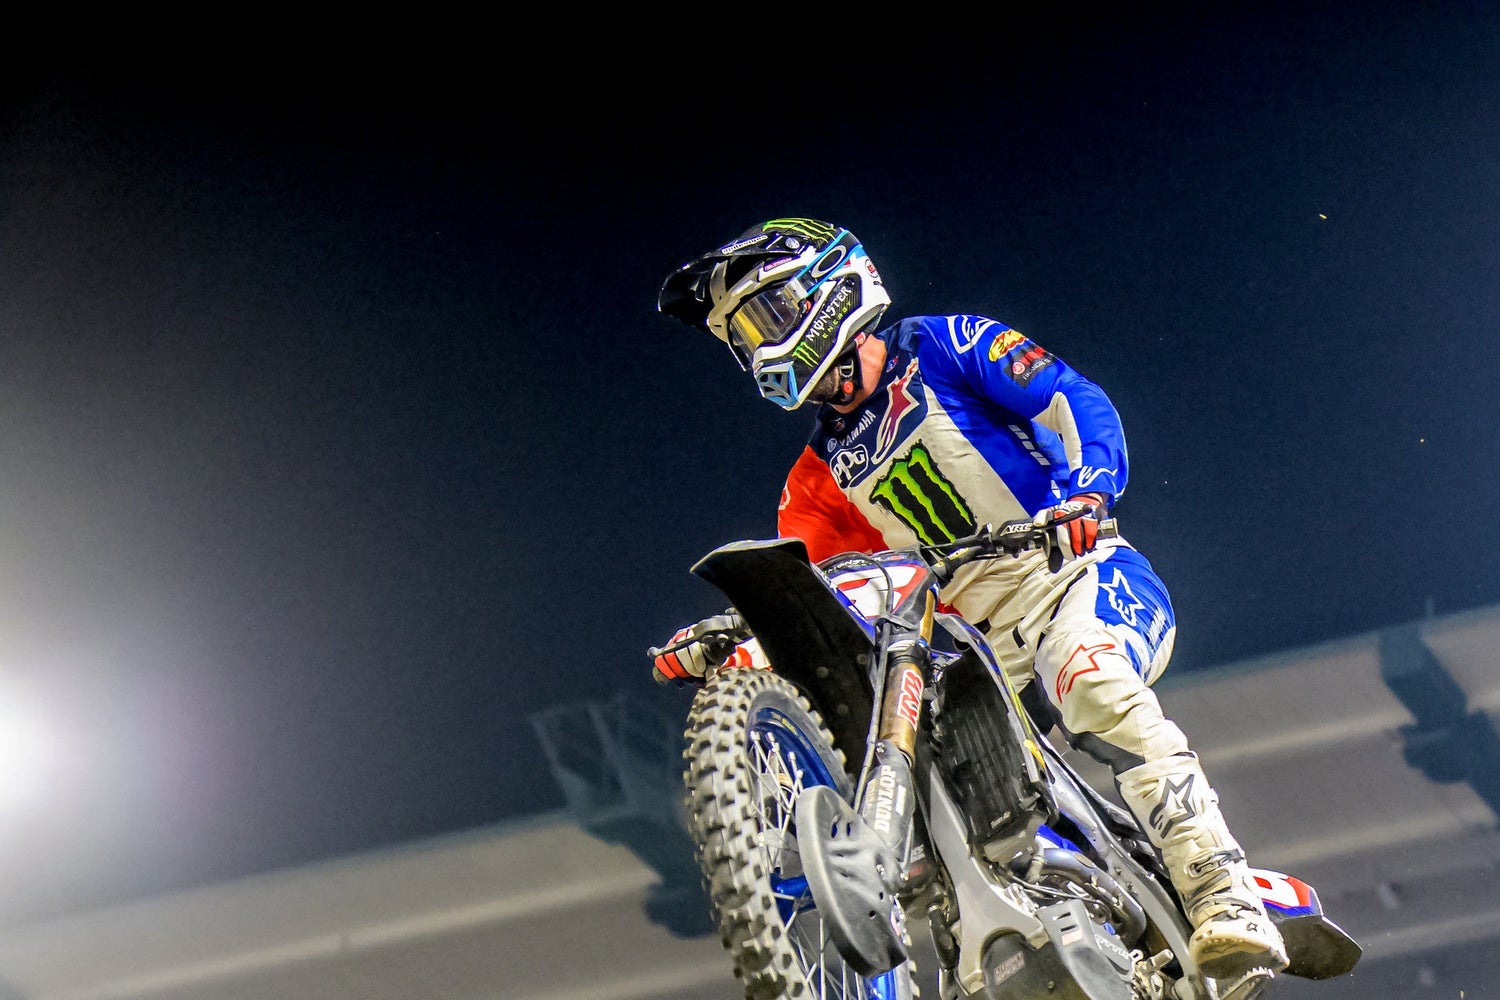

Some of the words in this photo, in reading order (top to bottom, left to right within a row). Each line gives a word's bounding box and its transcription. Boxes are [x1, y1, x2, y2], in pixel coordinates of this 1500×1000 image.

[805, 286, 852, 342] MONSTER
[839, 409, 877, 447] YAMAHA
[832, 449, 866, 483] PPG
[999, 523, 1033, 537] ARC
[874, 764, 897, 834] DUNLOP
